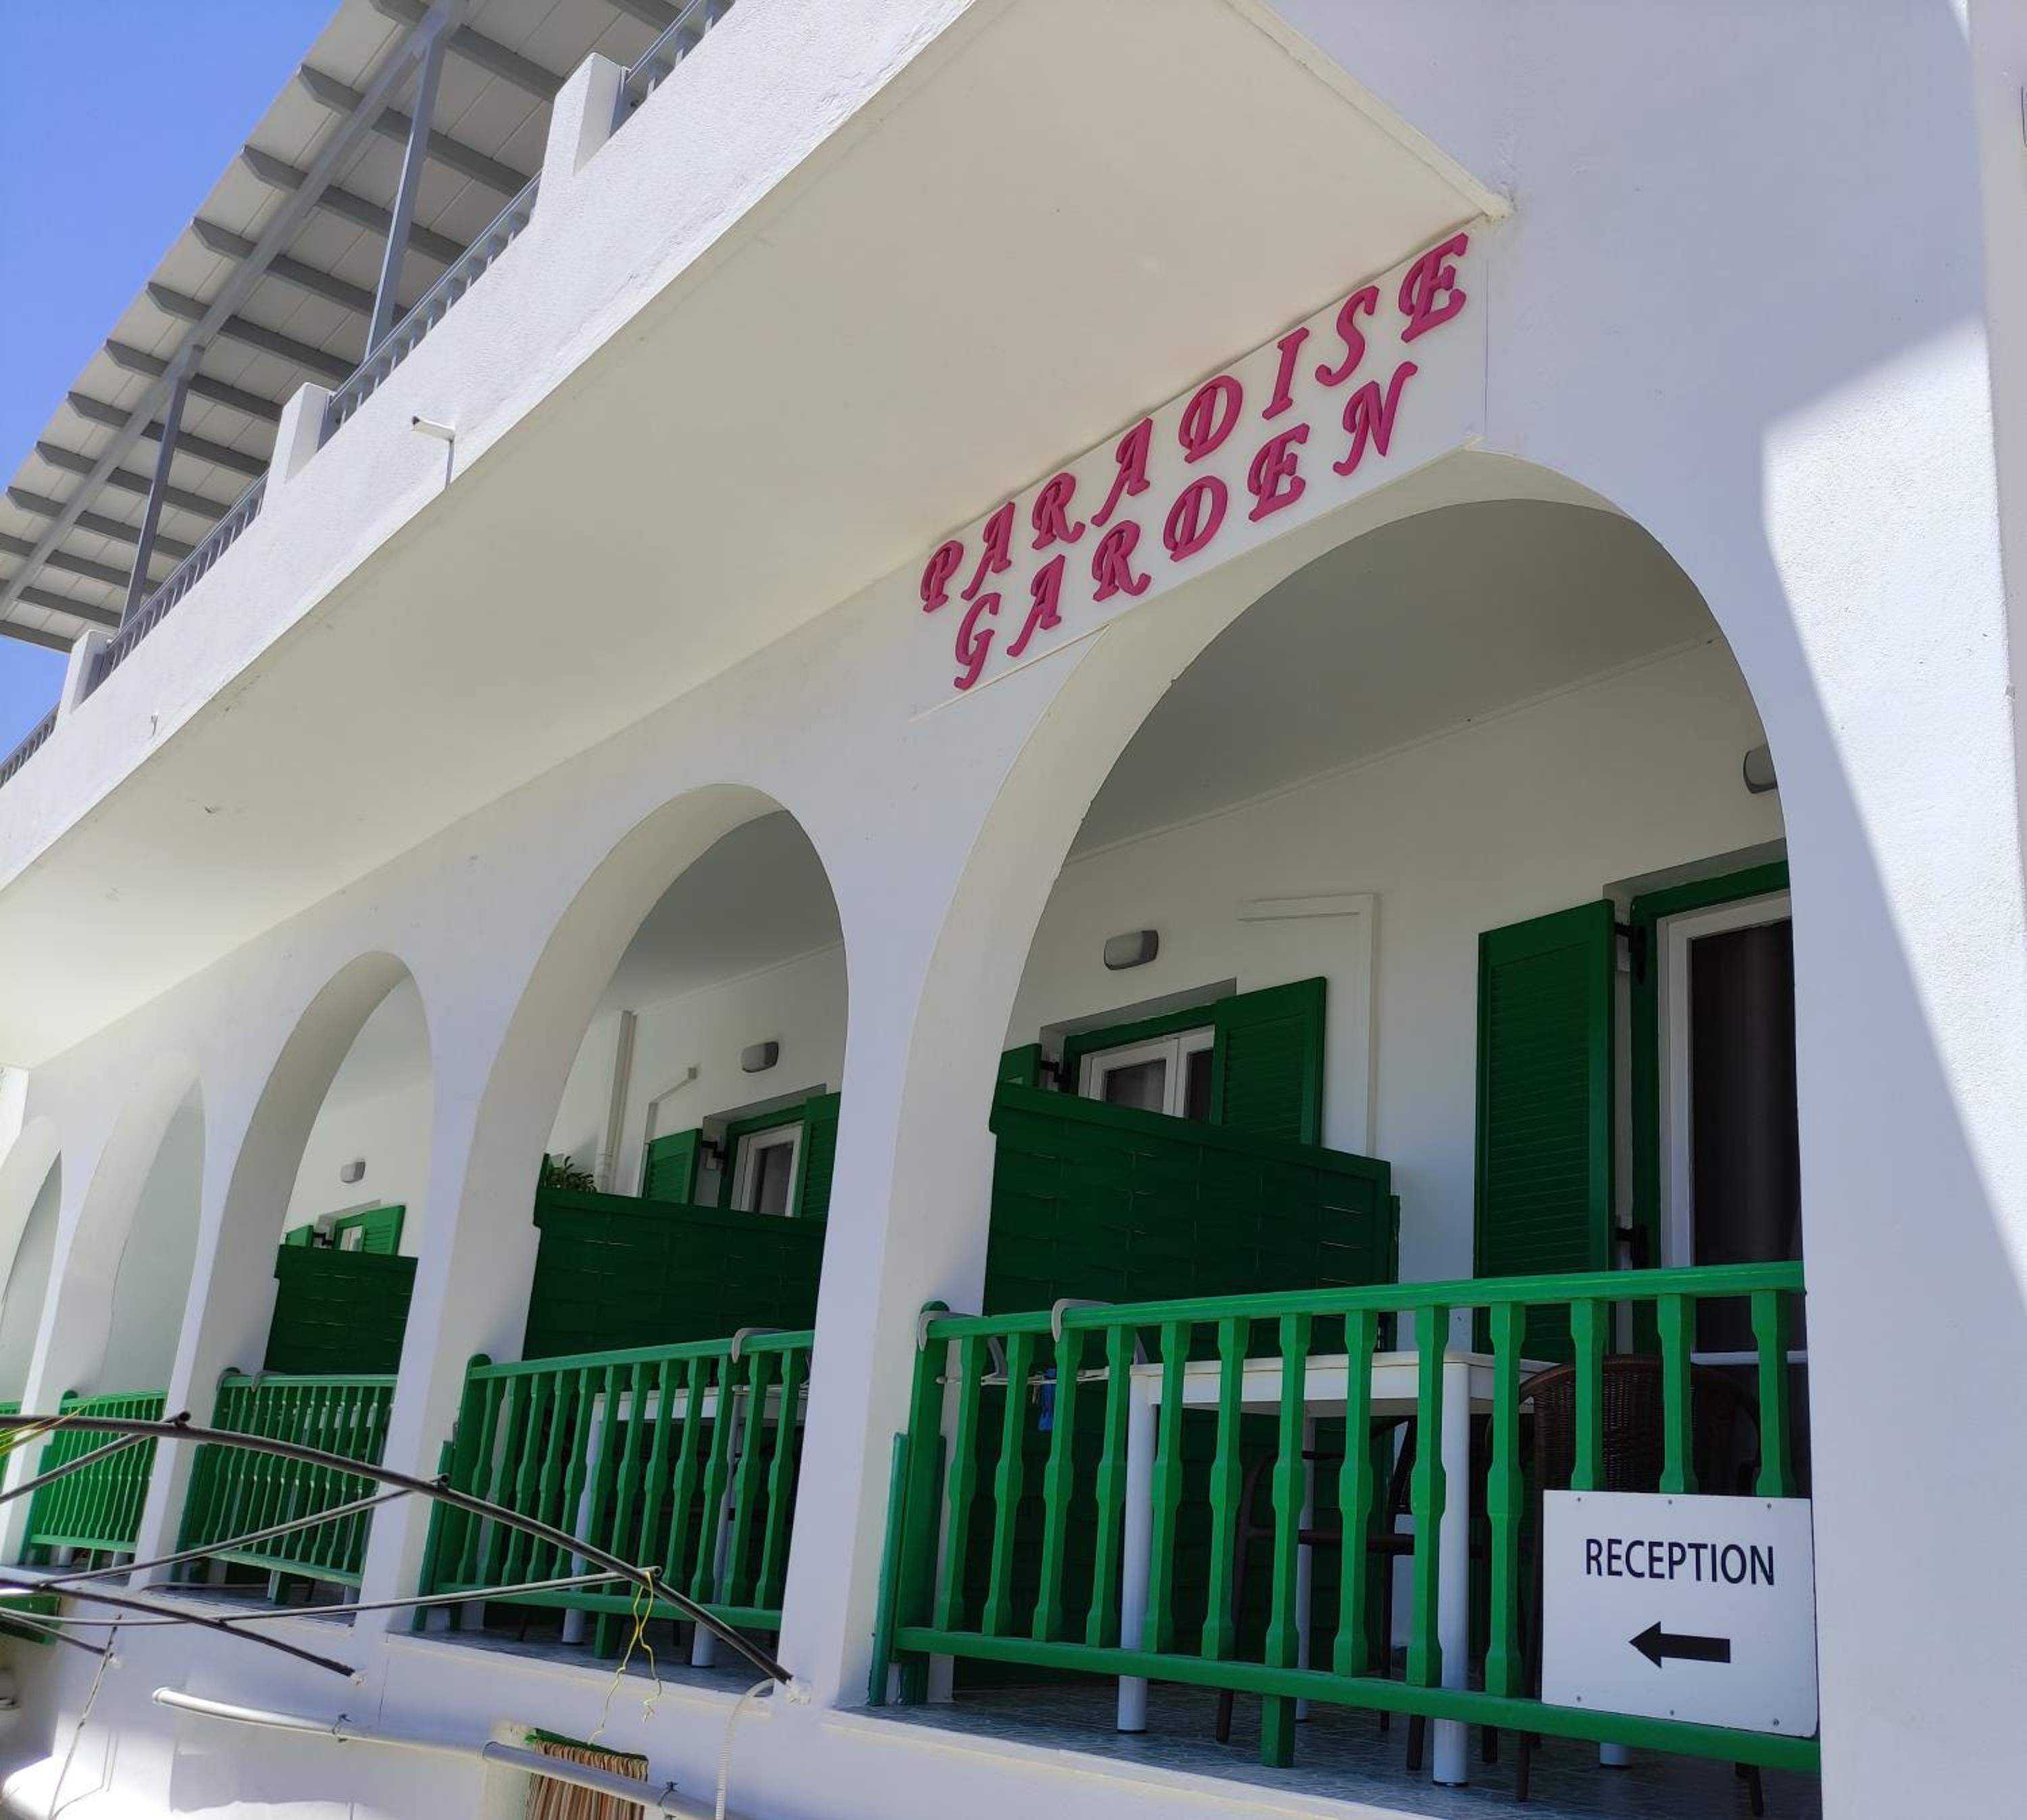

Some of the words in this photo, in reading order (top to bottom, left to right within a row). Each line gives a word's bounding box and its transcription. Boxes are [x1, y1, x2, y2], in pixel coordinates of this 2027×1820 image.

[920, 232, 1469, 613] PARADISE
[953, 361, 1418, 690] GARDEN
[1585, 1538, 1775, 1586] RECEPTION
